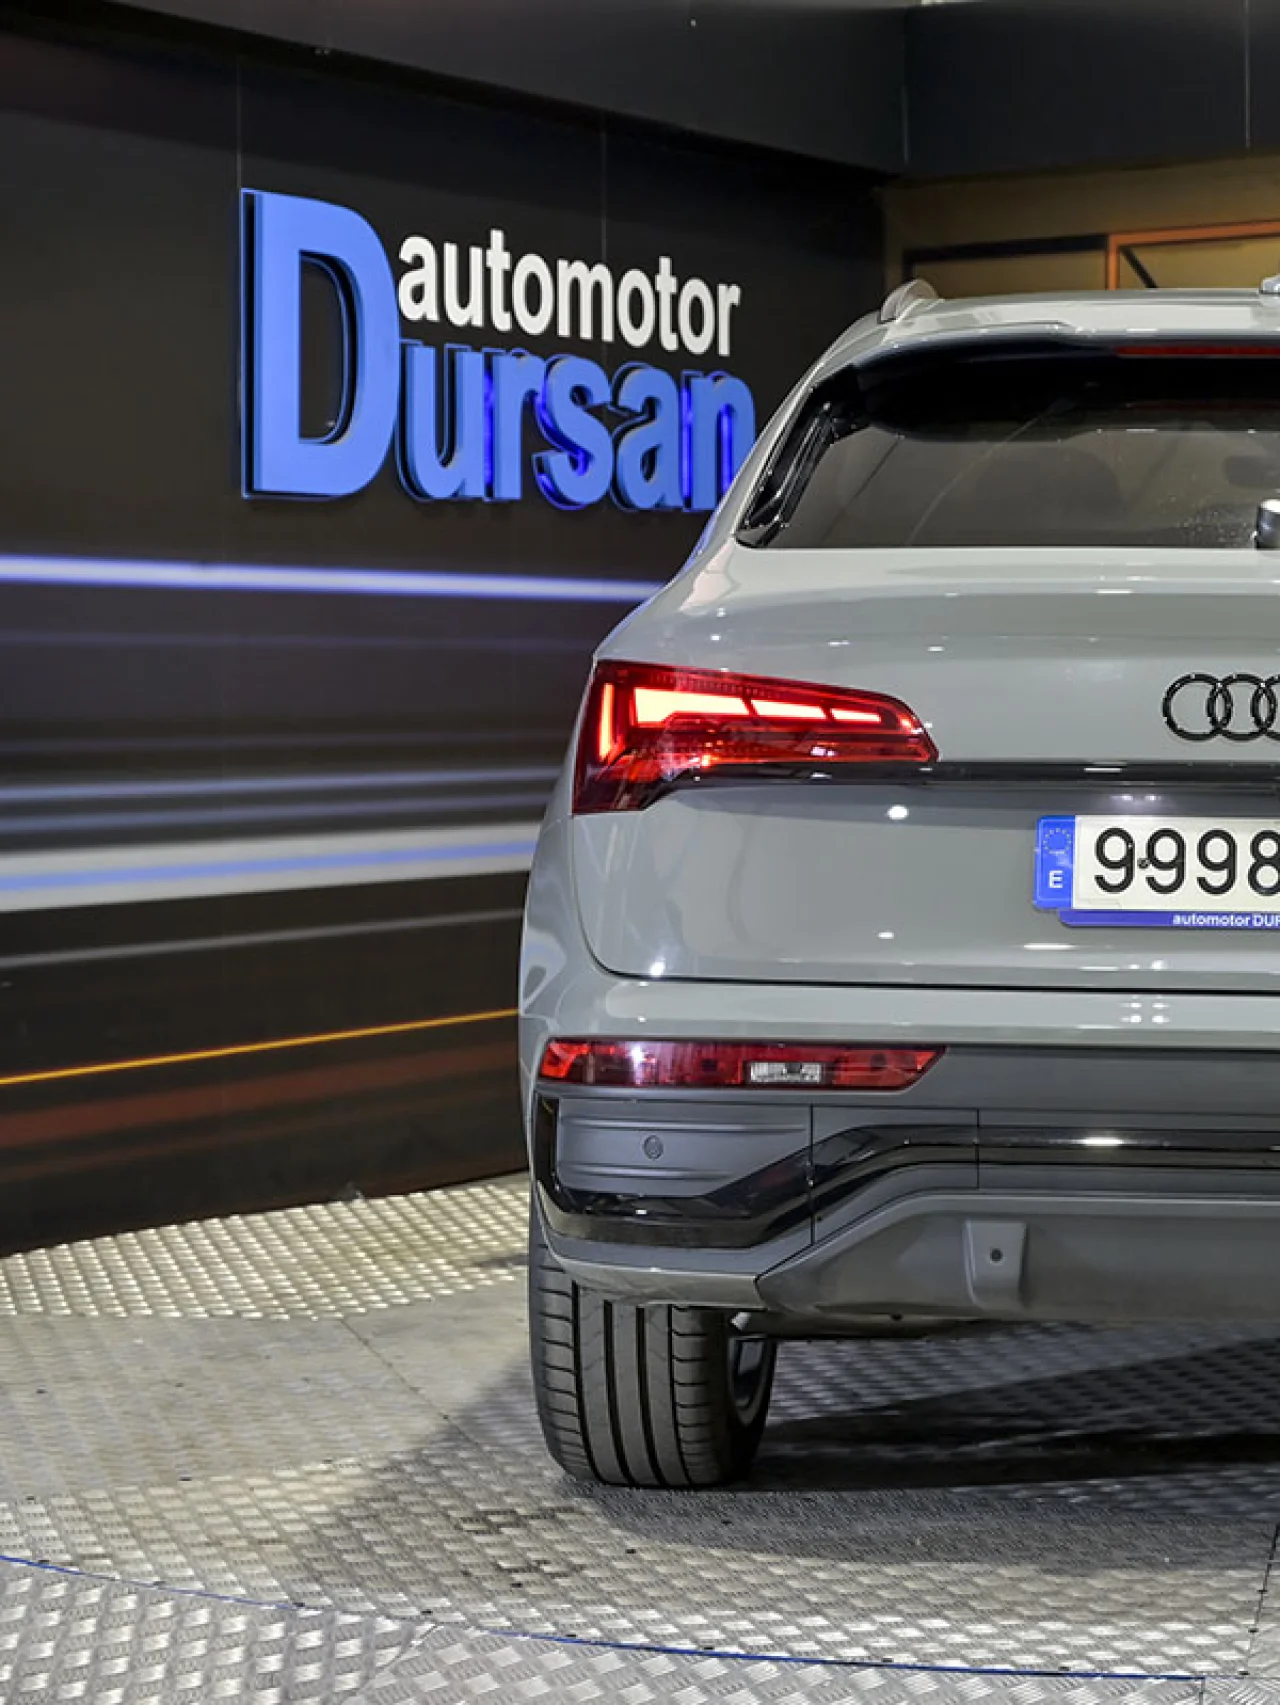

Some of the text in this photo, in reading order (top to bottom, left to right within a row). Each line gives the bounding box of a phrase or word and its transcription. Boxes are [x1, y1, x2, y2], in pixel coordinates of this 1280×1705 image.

[241, 187, 756, 512] Dursan
[399, 229, 741, 357] automotor
[1049, 869, 1063, 889] E
